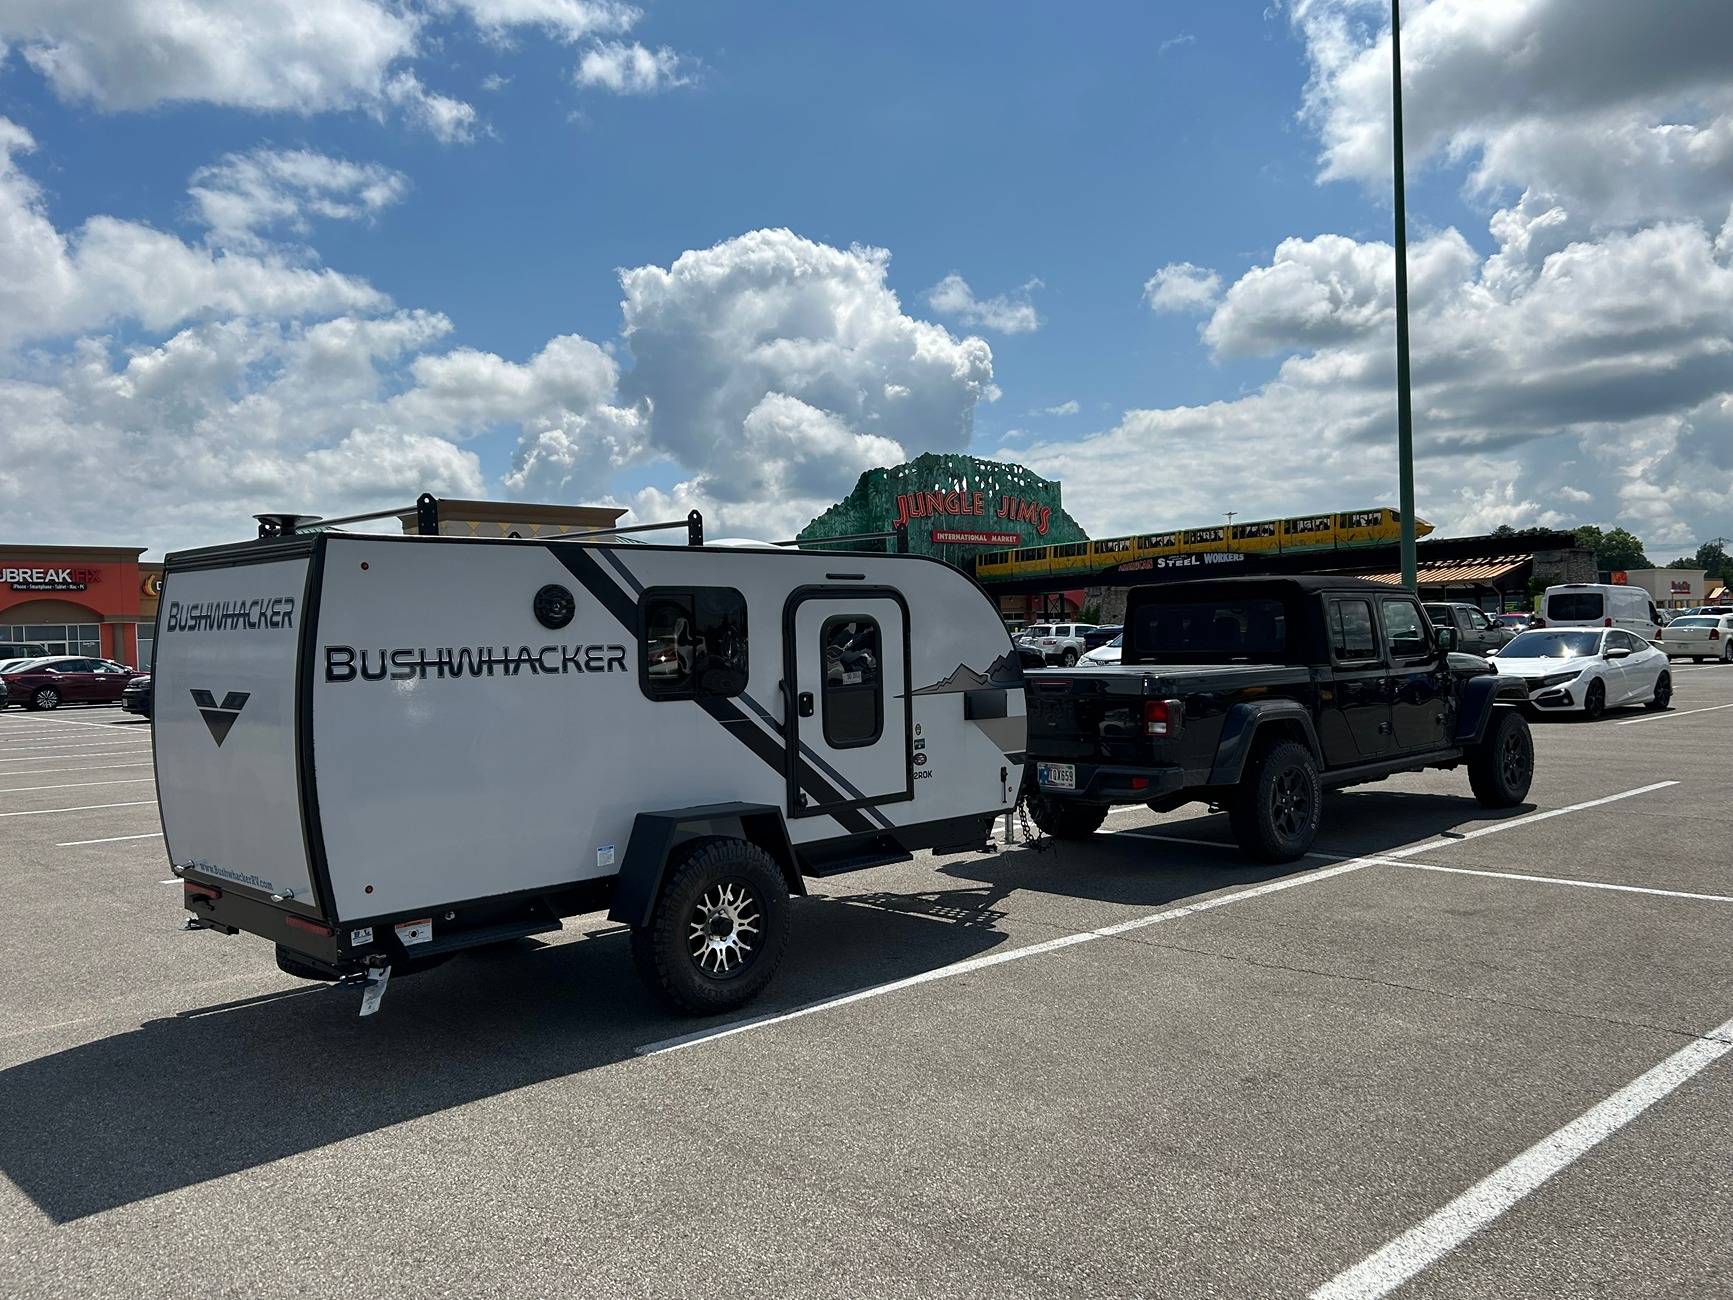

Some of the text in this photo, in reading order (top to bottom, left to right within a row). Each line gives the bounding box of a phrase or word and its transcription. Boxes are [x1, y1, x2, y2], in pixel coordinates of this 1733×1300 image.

[893, 491, 1052, 535] JUNGLE JIM'S
[937, 533, 1017, 543] INTERNATIONAL MARKET
[1157, 555, 1200, 568] STEEL
[1203, 554, 1244, 564] WORKERS
[324, 644, 628, 683] BUSHWHACKER
